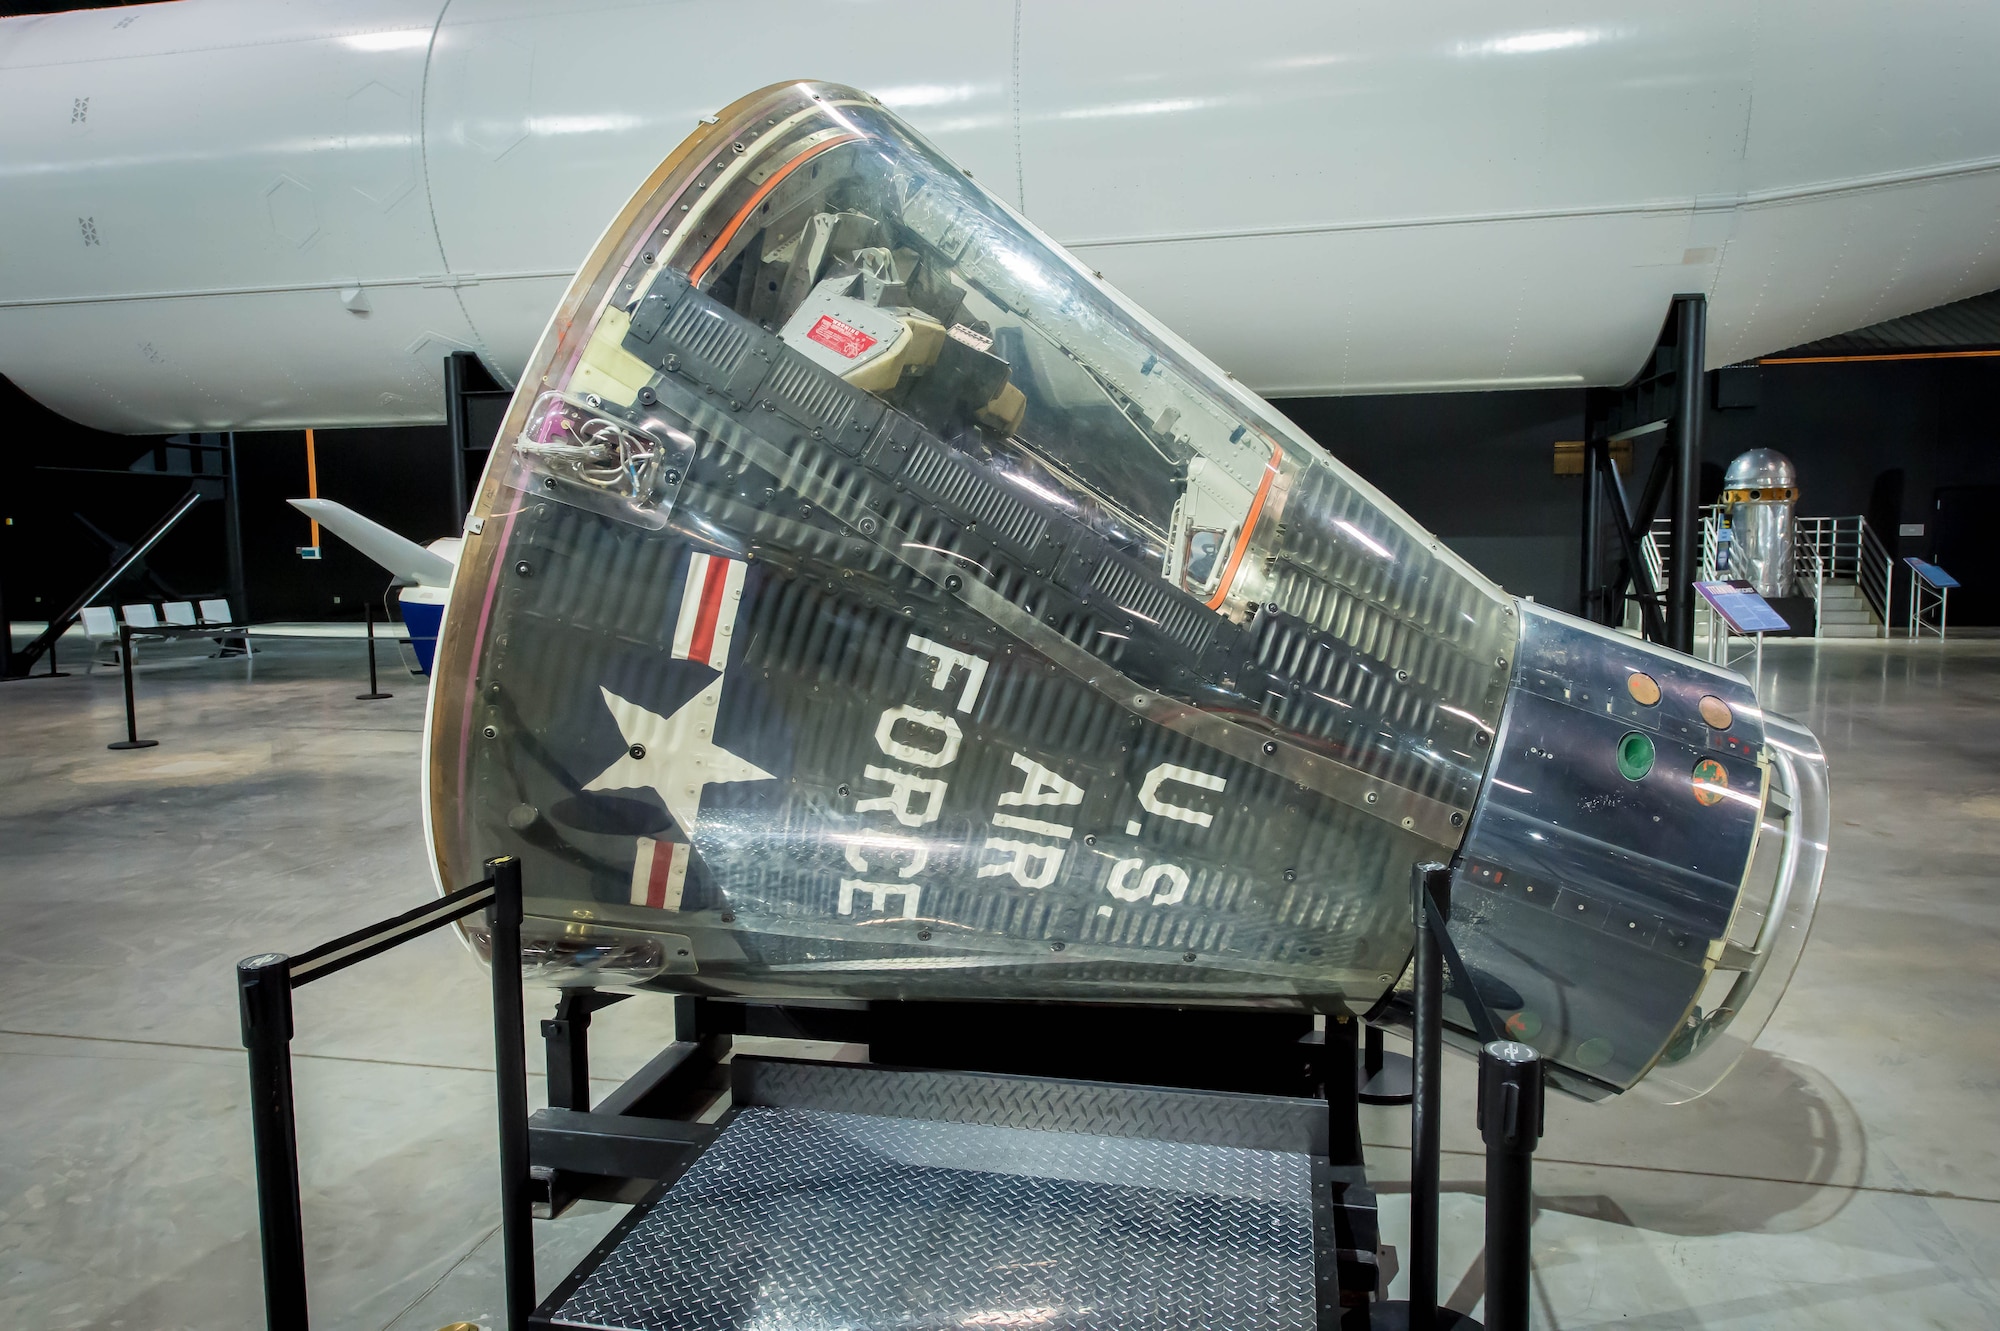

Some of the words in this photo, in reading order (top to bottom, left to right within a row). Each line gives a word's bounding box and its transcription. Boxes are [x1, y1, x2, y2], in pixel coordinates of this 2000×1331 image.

[832, 319, 861, 336] WARNING
[838, 634, 989, 919] FORCE
[978, 752, 1085, 889] AIR
[1097, 763, 1227, 917] U.S.
